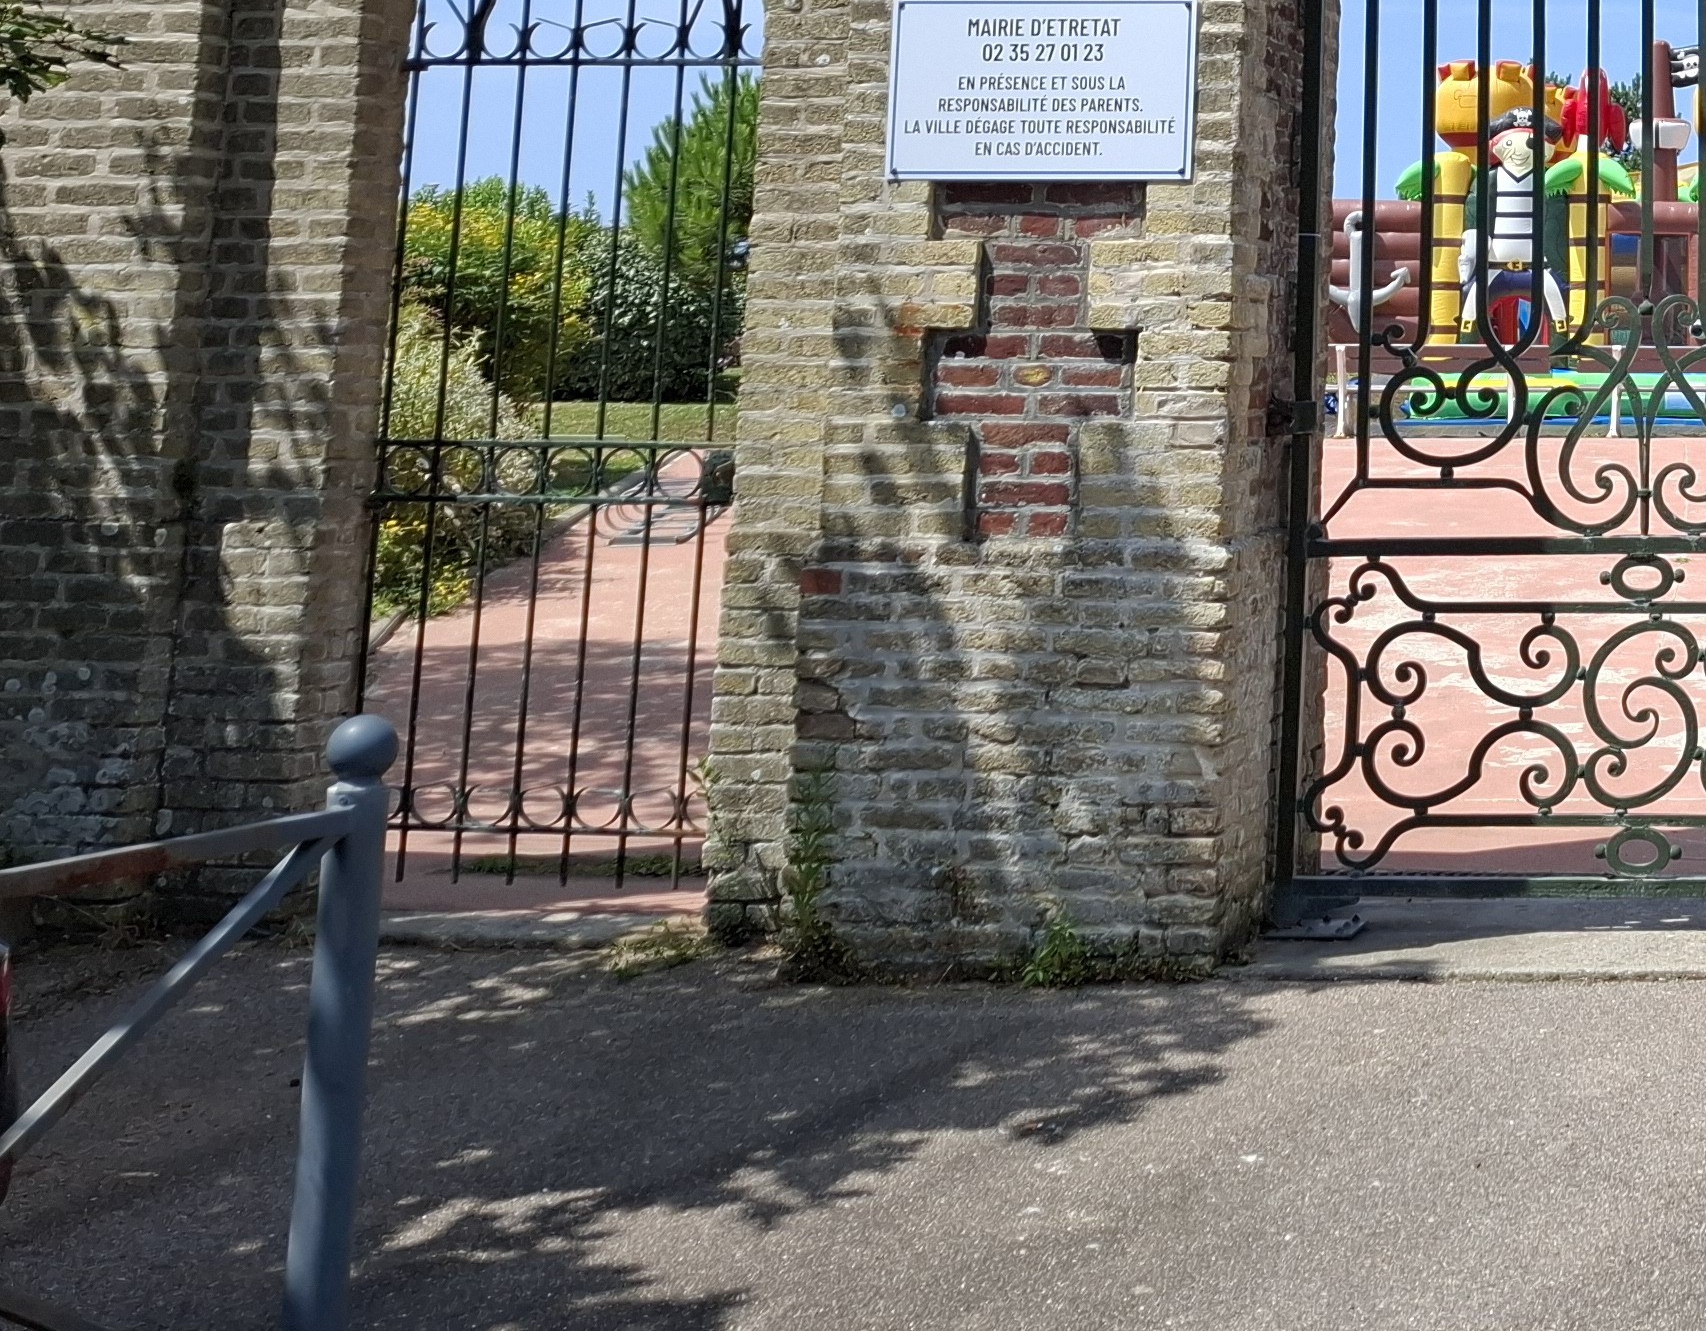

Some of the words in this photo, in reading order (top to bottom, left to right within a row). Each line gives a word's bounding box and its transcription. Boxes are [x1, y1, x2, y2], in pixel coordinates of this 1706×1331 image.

[967, 18, 1026, 37] MAIRIE
[1030, 18, 1122, 37] D'ETRETAT
[982, 43, 1004, 62] 02
[1008, 43, 1030, 62] 35
[1034, 43, 1056, 62] 27
[1060, 43, 1078, 62] 01
[1083, 43, 1104, 62] 23
[957, 75, 976, 91] EN
[979, 72, 1048, 91] PRÉSENCE
[1050, 75, 1068, 91] ET
[1071, 75, 1105, 91] SOUS
[1108, 75, 1126, 91] LA
[937, 94, 1049, 113] RESPONSABILITÉ
[1051, 97, 1077, 113] DES
[1080, 97, 1144, 113] PARENTS.
[903, 119, 921, 135] LA
[924, 119, 962, 135] VILLE
[965, 116, 1017, 135] DÉGAGE
[1019, 119, 1063, 135] TOUTE
[1065, 115, 1176, 135] RESPONSABILITÉ
[974, 141, 993, 157] EN
[996, 141, 1021, 157] CAS
[1024, 141, 1103, 157] D'ACCIDENT.
